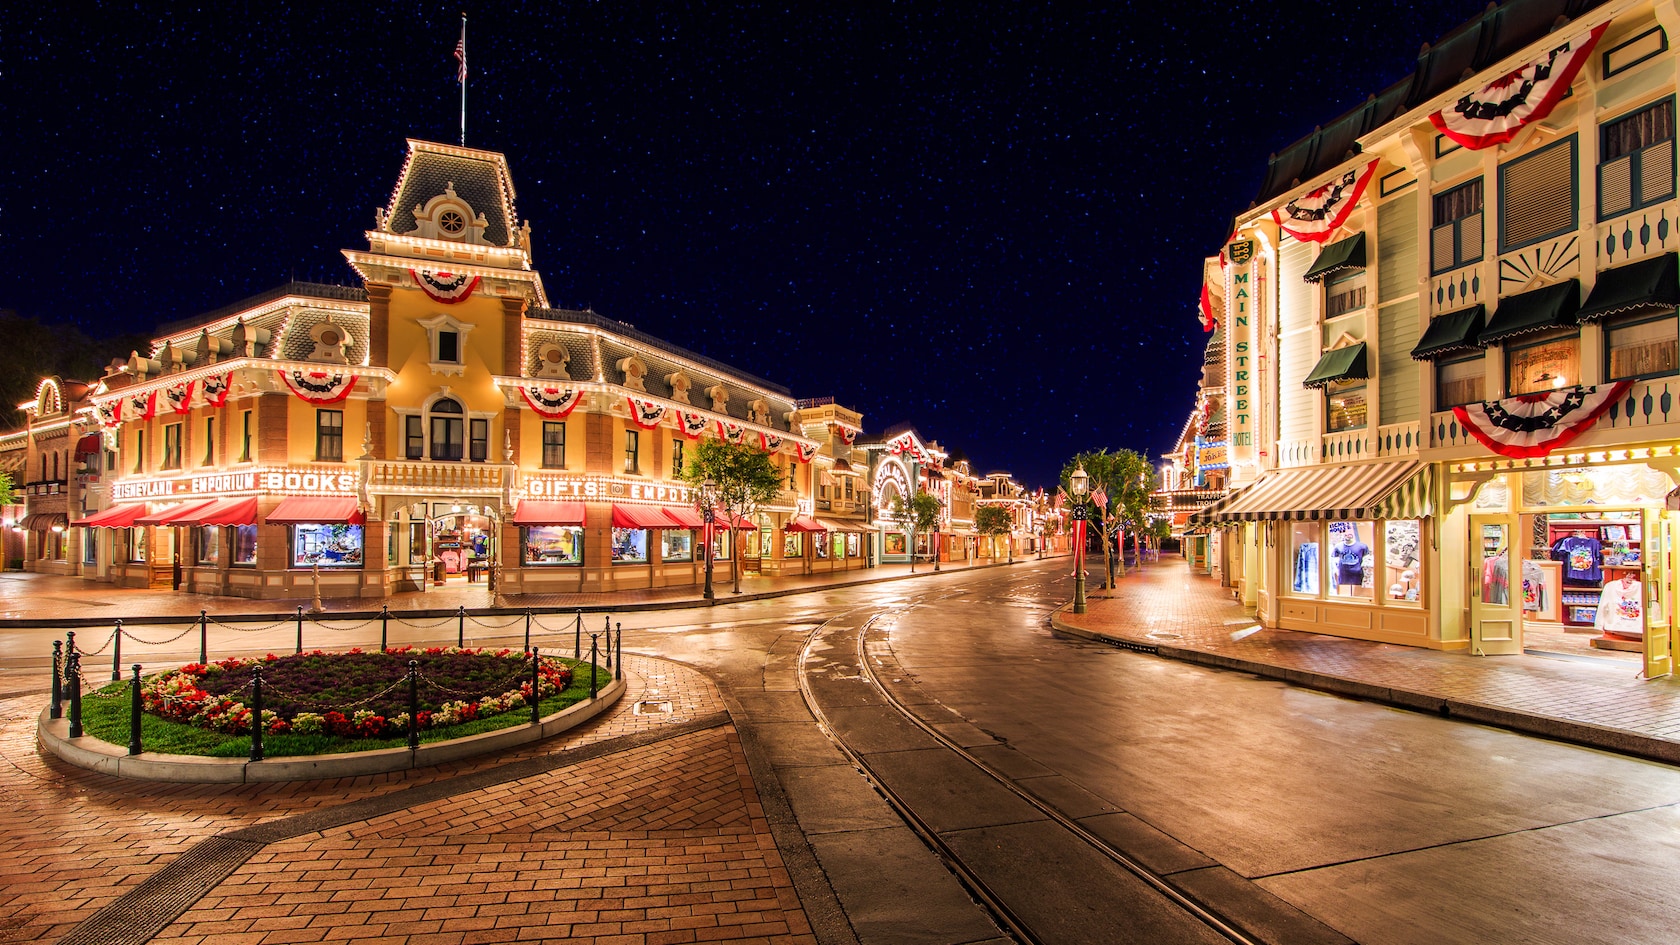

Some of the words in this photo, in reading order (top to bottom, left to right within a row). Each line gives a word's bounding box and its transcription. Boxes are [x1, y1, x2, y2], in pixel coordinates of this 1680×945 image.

[1234, 273, 1249, 327] MAIN
[1235, 341, 1249, 425] STREET
[1233, 432, 1252, 446] HOTEL
[115, 480, 173, 499] DISNEYLAND
[191, 473, 255, 493] EMPORIUM
[267, 473, 355, 491] BOOKS
[530, 480, 598, 496] GIFTS
